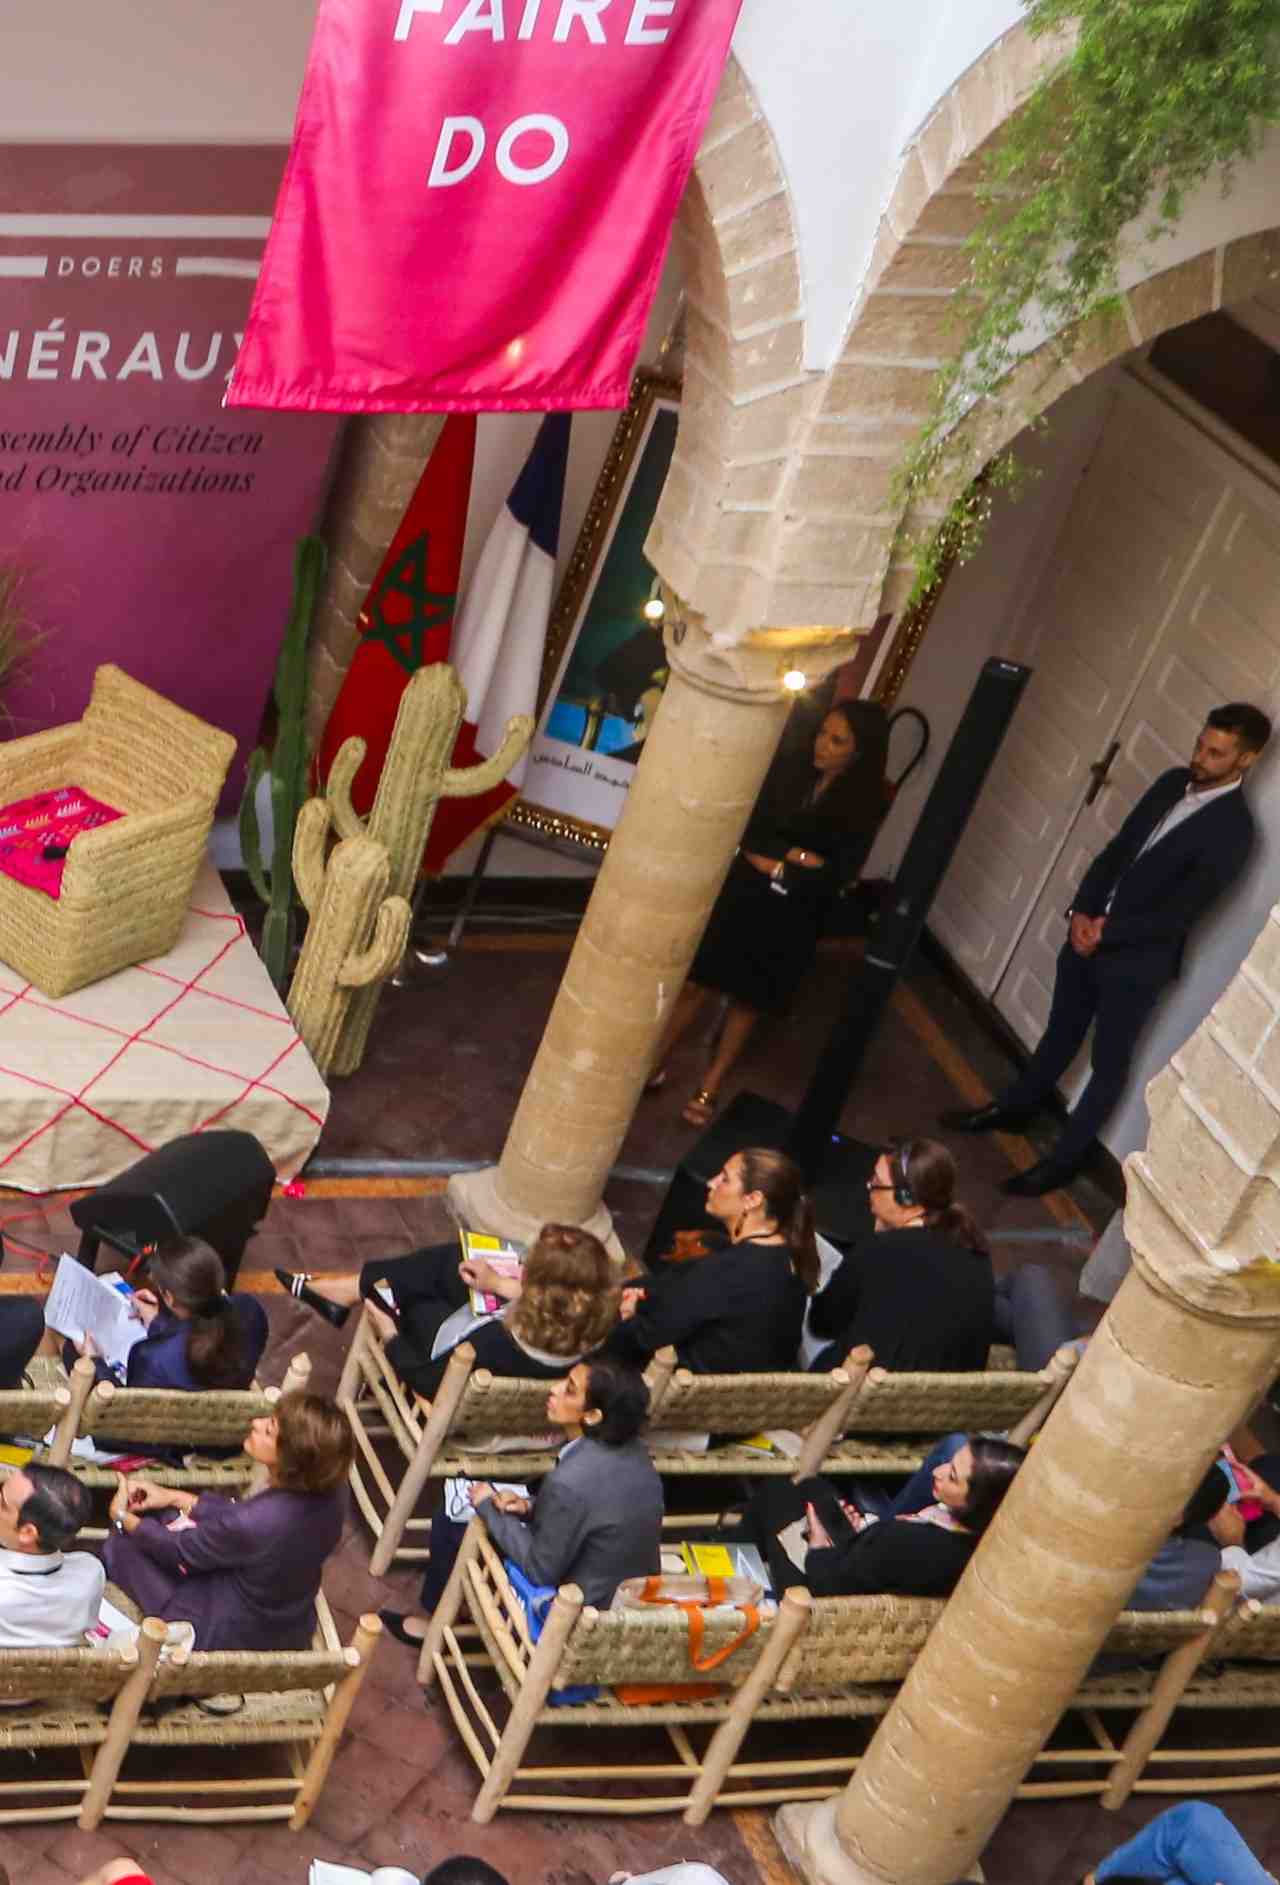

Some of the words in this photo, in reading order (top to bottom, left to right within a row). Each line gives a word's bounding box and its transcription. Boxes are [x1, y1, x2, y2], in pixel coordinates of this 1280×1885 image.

[393, 0, 675, 46] FAIRE
[427, 113, 569, 187] DO
[57, 256, 164, 278] DOERS
[112, 423, 149, 458] of
[153, 424, 263, 454] Citizen
[35, 463, 256, 496] Organizations
